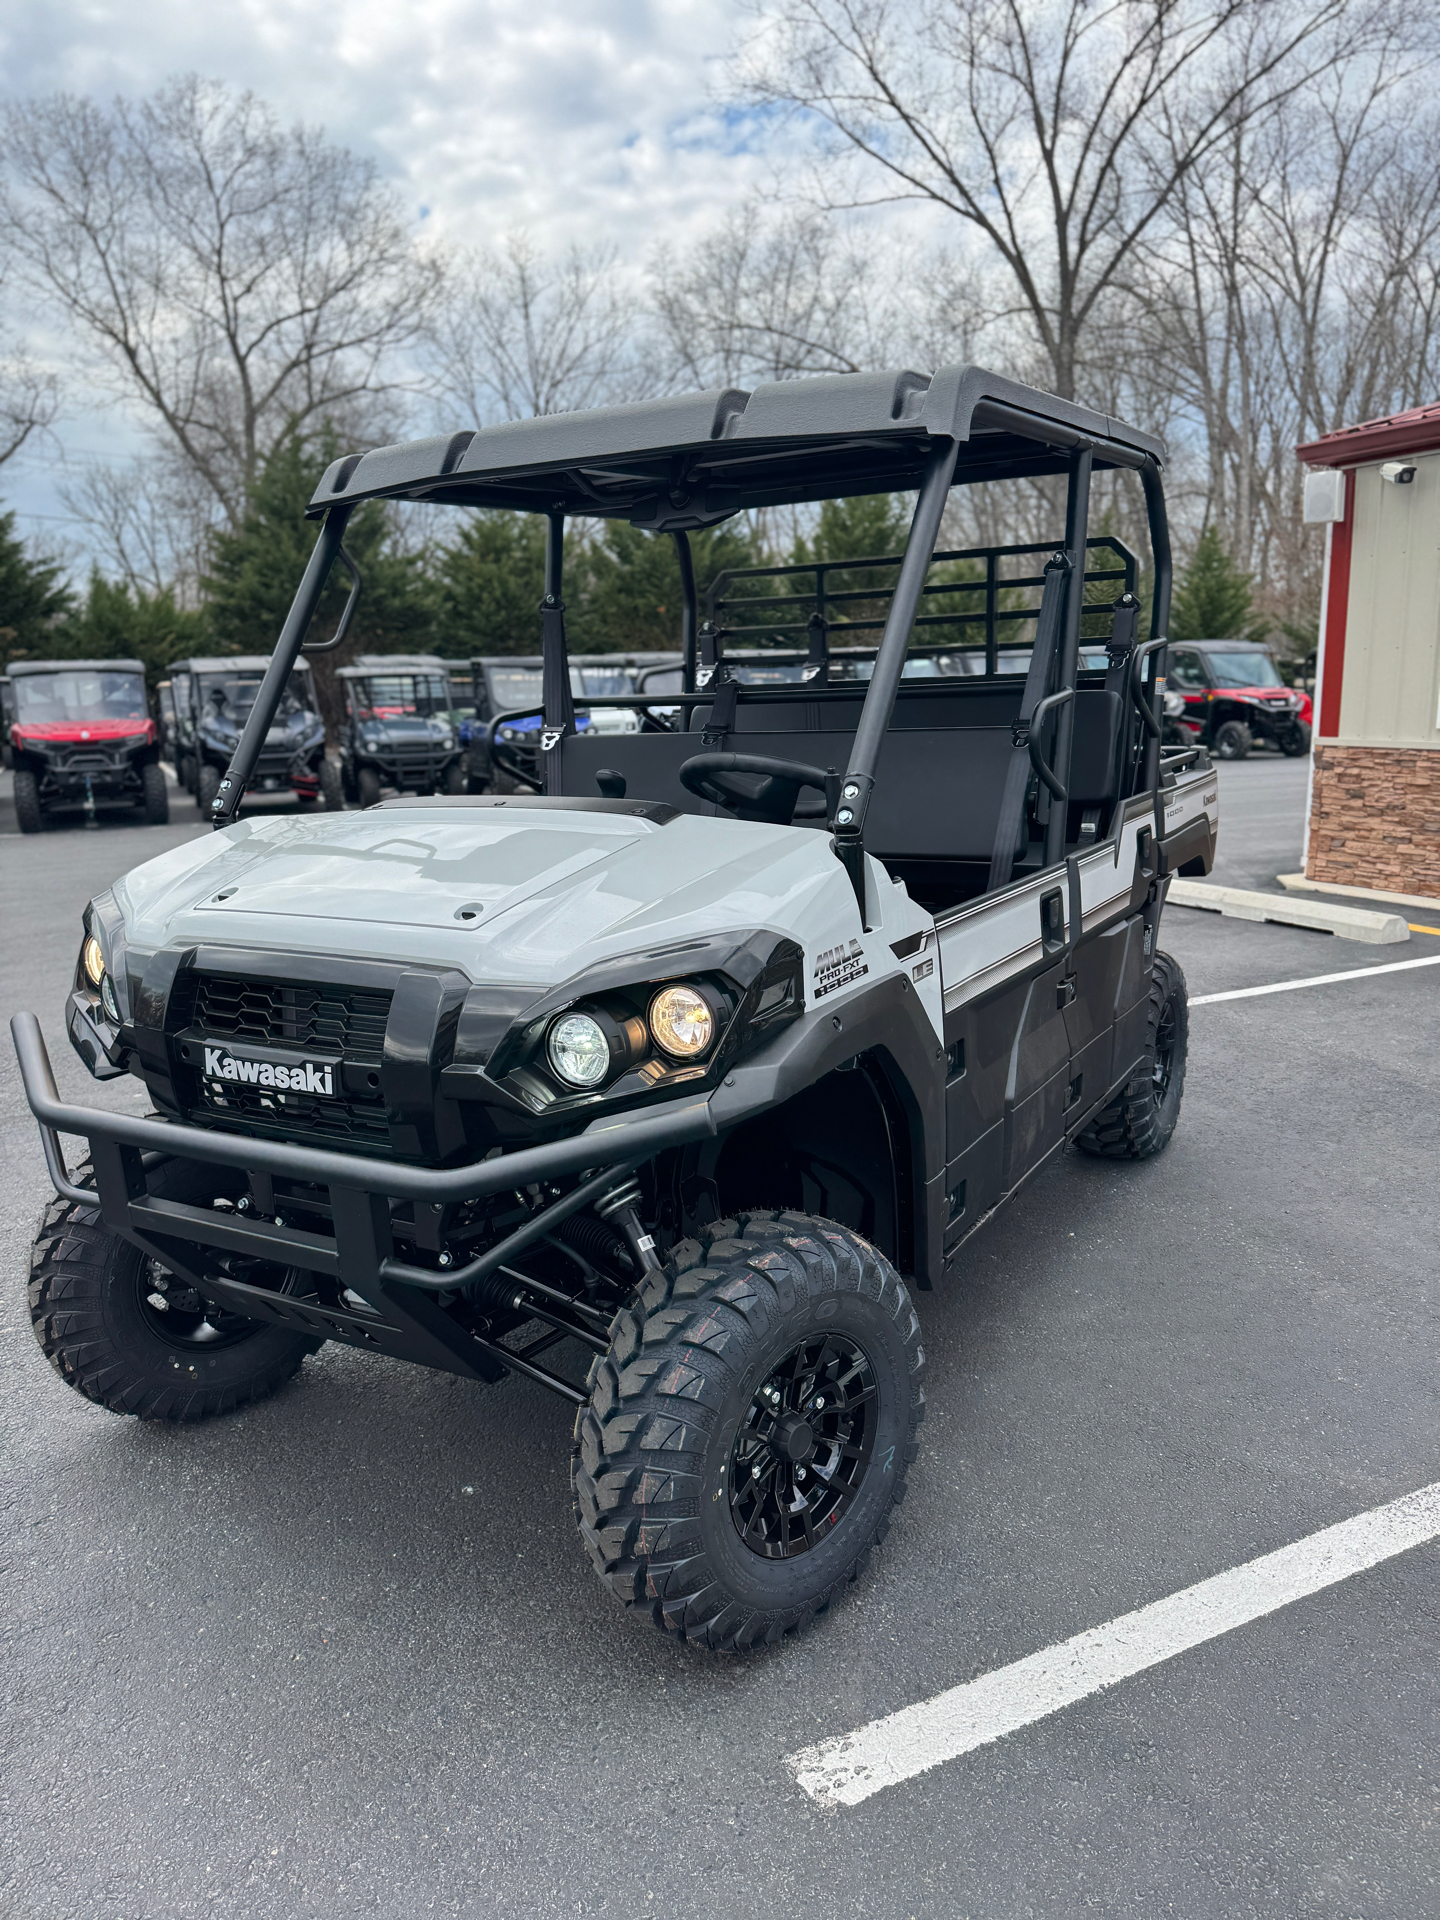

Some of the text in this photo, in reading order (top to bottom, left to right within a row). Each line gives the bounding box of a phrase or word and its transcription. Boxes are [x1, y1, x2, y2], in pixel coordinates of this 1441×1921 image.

[1166, 806, 1184, 818] 1000
[814, 938, 865, 979] MULE
[912, 959, 933, 983] LE
[817, 966, 867, 997] 1000
[204, 1047, 333, 1095] Kawasaki
